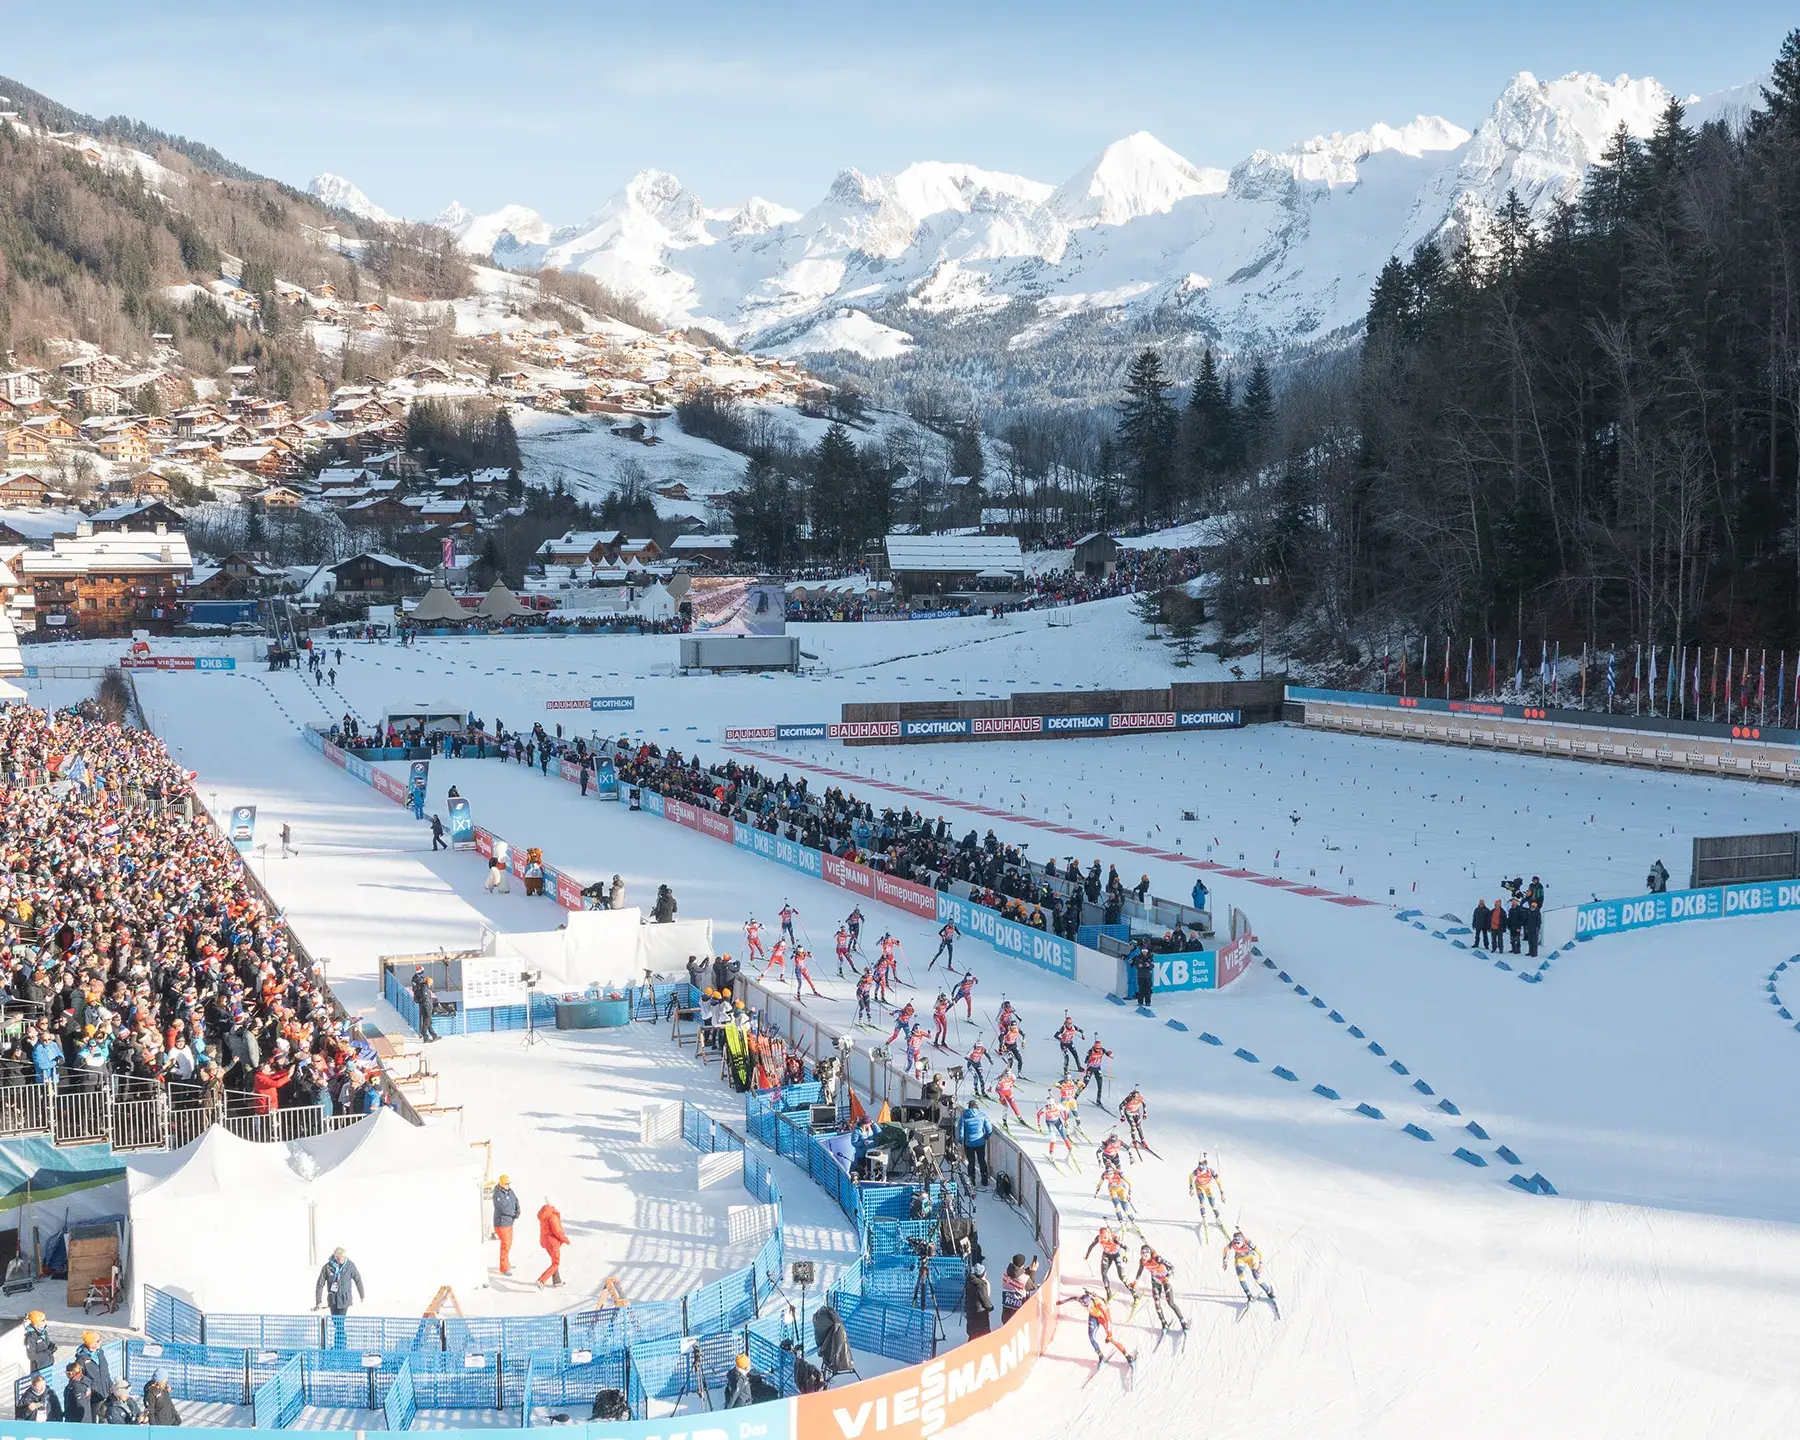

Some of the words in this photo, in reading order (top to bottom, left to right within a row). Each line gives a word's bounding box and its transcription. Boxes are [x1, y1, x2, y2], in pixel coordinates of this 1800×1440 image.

[157, 659, 195, 667] VIESSMANN
[201, 659, 222, 668] DKB
[547, 700, 591, 709] BAUHAUS
[593, 699, 633, 708] DECATHLON
[975, 719, 1040, 732] BAUHAUS
[1048, 716, 1103, 729] DECATHLON
[1112, 713, 1174, 727] BAUHAUS
[1181, 712, 1234, 724] DECATHLON
[727, 728, 775, 739] BAUHAUS
[780, 727, 824, 737] DECATHLON
[830, 723, 898, 737] BAUHAUS
[907, 721, 966, 734] DECATHLON
[599, 774, 614, 784] iX1
[667, 801, 695, 822] VIESSMANN
[453, 819, 471, 832] iX1
[702, 813, 713, 830] Heat
[713, 819, 729, 835] pumps
[735, 825, 748, 846] DKB
[754, 833, 769, 853] DKB
[776, 841, 792, 862] DKB
[799, 849, 815, 870] DKB
[827, 860, 869, 887] VIESSMANN
[876, 876, 935, 910] Wärmepumpen
[1726, 888, 1761, 911] DKB
[939, 897, 961, 924] DKB
[1622, 900, 1655, 925] DKB
[1671, 893, 1706, 918] DKB
[971, 908, 994, 937] DKB
[1577, 907, 1606, 933] DKB
[995, 922, 1022, 952] DKB
[1033, 936, 1061, 967] DKB
[1192, 959, 1206, 967] Das
[1192, 967, 1209, 975] kann
[1153, 960, 1189, 987] KB
[1192, 975, 1209, 984] Bank
[833, 1321, 1031, 1438] VIESSMANN
[740, 1422, 767, 1439] Das
